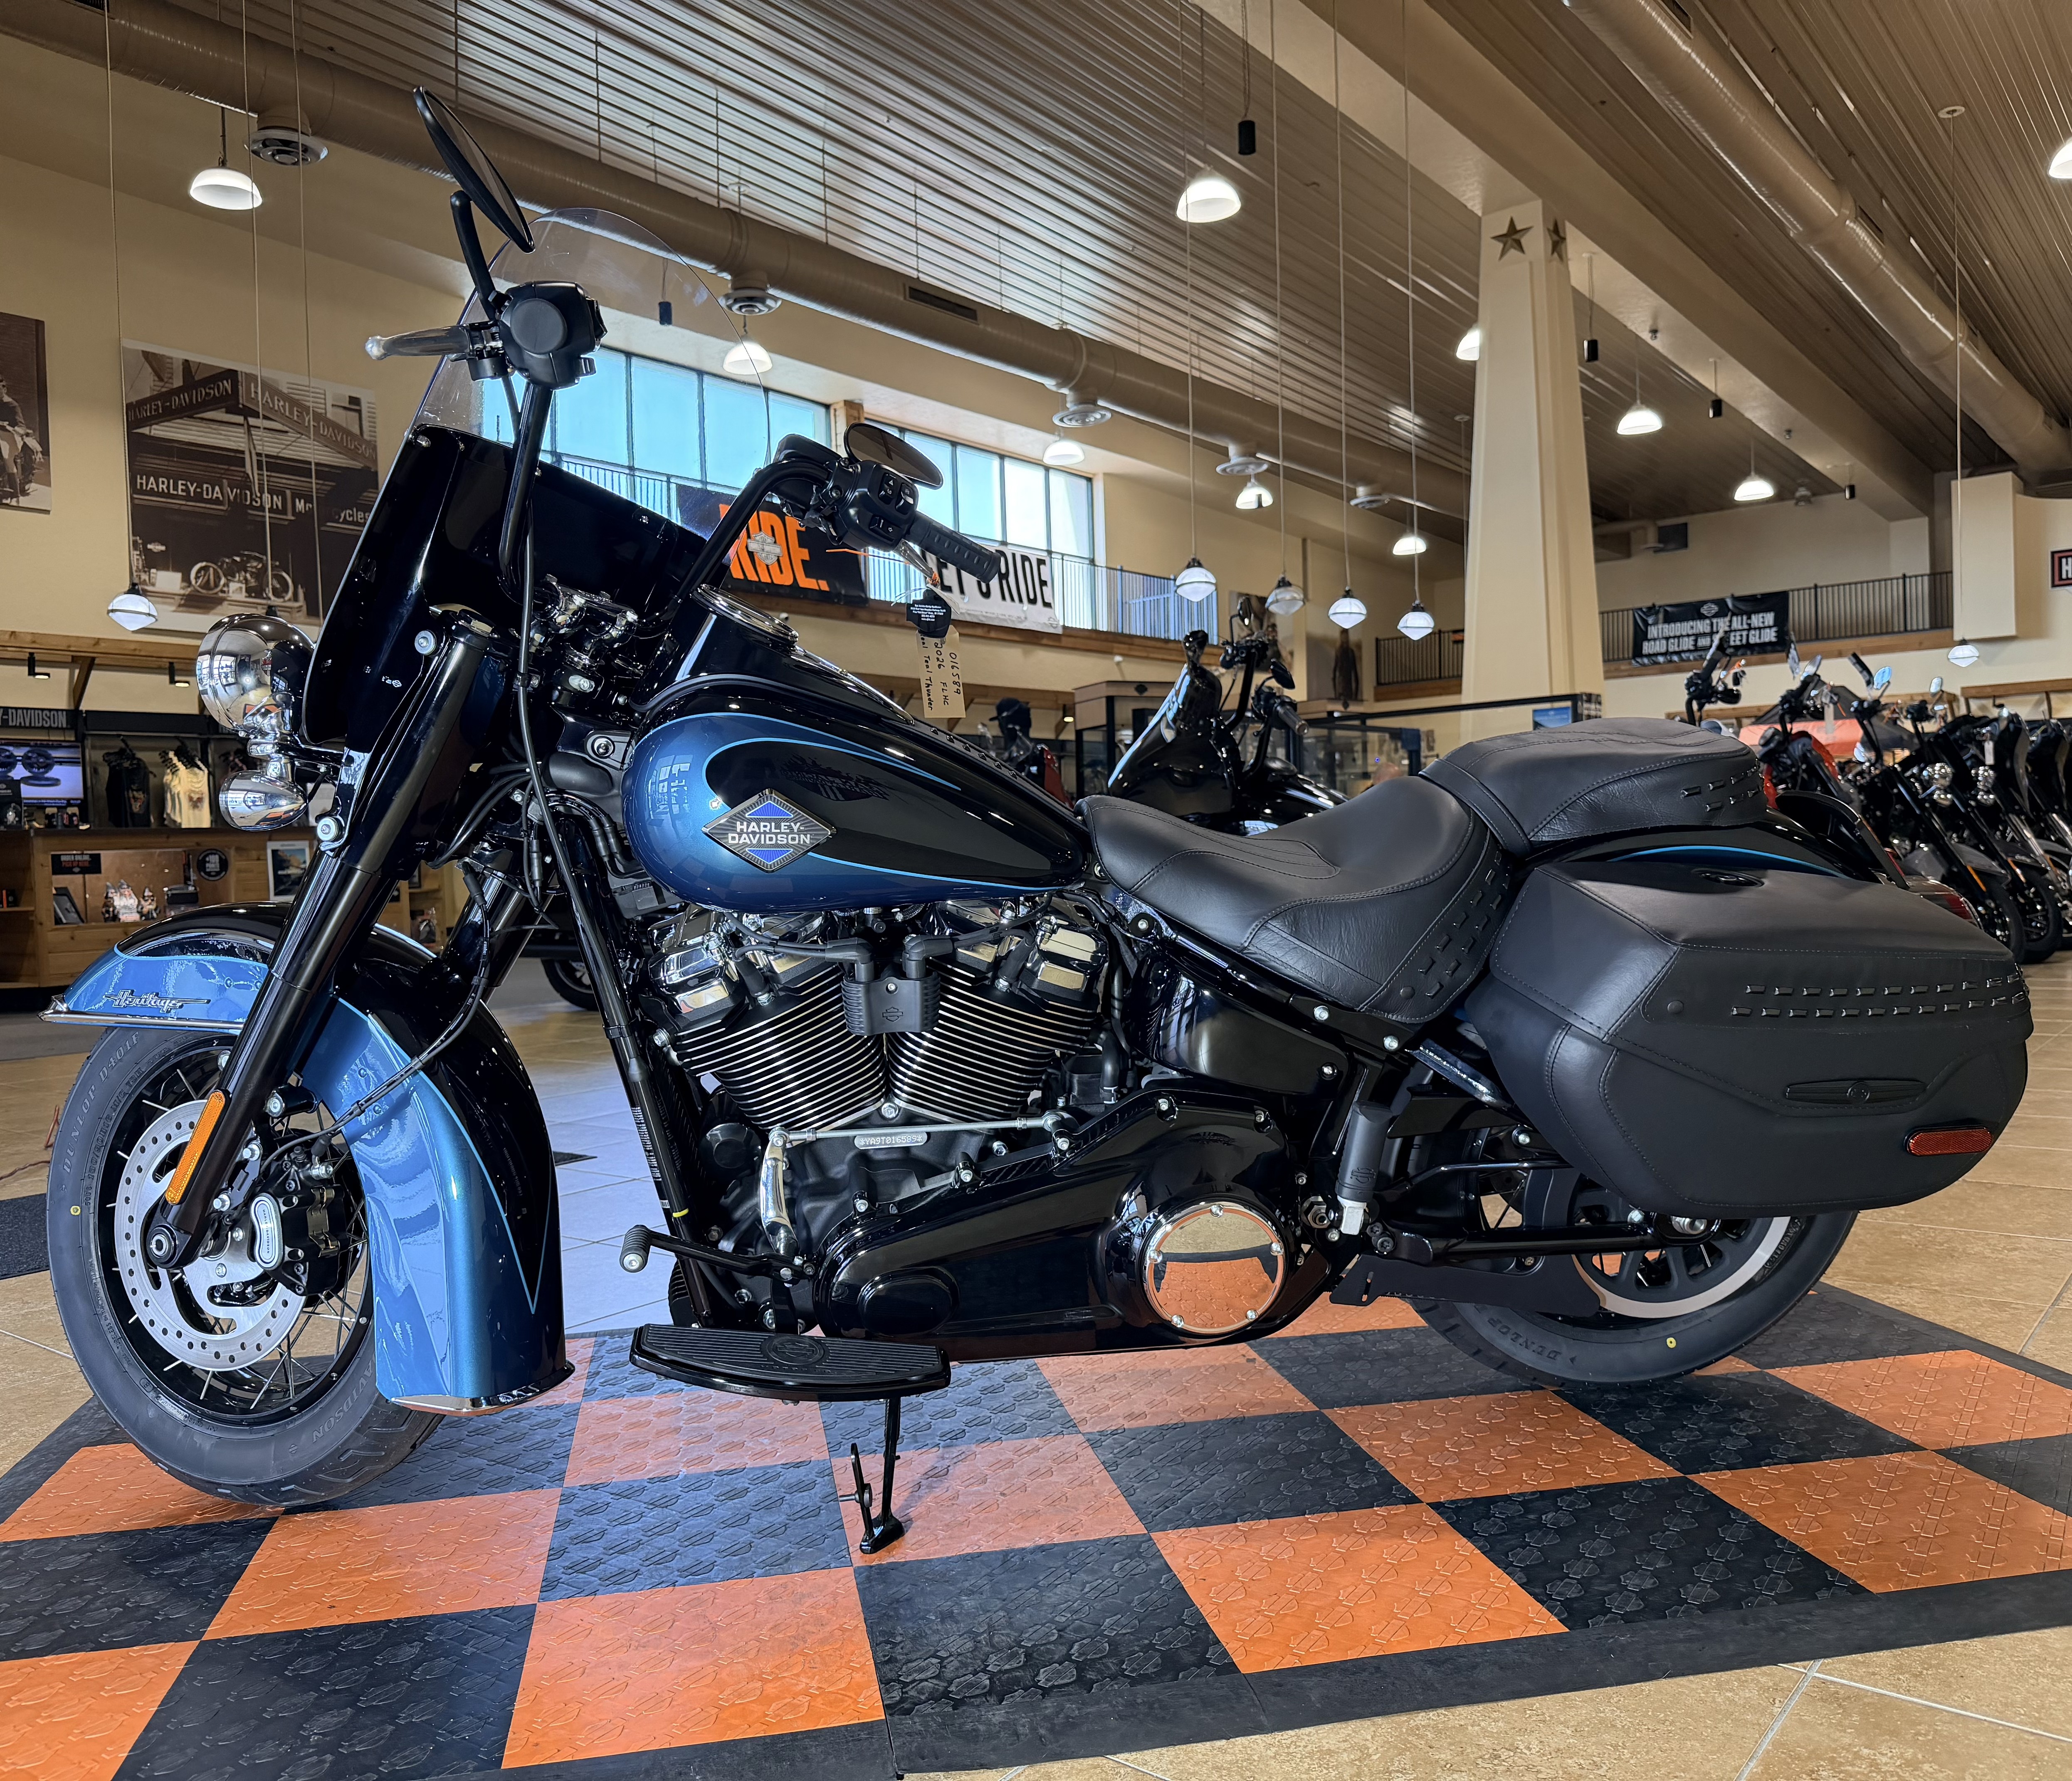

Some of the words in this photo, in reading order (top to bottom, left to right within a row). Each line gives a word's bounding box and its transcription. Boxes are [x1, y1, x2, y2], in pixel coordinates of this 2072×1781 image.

[128, 379, 232, 422] HARLEY-DAVIDSON
[136, 475, 282, 511] HARLEY-DAVIDSON
[995, 549, 1052, 609] RIDE
[920, 635, 928, 648] eal
[1642, 639, 1667, 655] ROAD
[1668, 636, 1696, 652] GLIDE
[1712, 630, 1748, 647] SEET
[1749, 627, 1778, 644] GLIDE
[1647, 618, 1711, 640] INTRODUCING
[1731, 611, 1775, 630] ALL-NEW
[924, 655, 933, 673] Teal
[934, 642, 945, 669] 2026
[940, 682, 949, 706] FLHC
[949, 652, 961, 694] 016589
[925, 677, 934, 711] Thunder
[728, 833, 810, 845] DAVIDSON
[736, 821, 805, 832] HARLEY-
[63, 1084, 96, 1174] DUNLOP
[99, 1031, 139, 1082] D401F
[313, 1356, 375, 1443] AVIDSON
